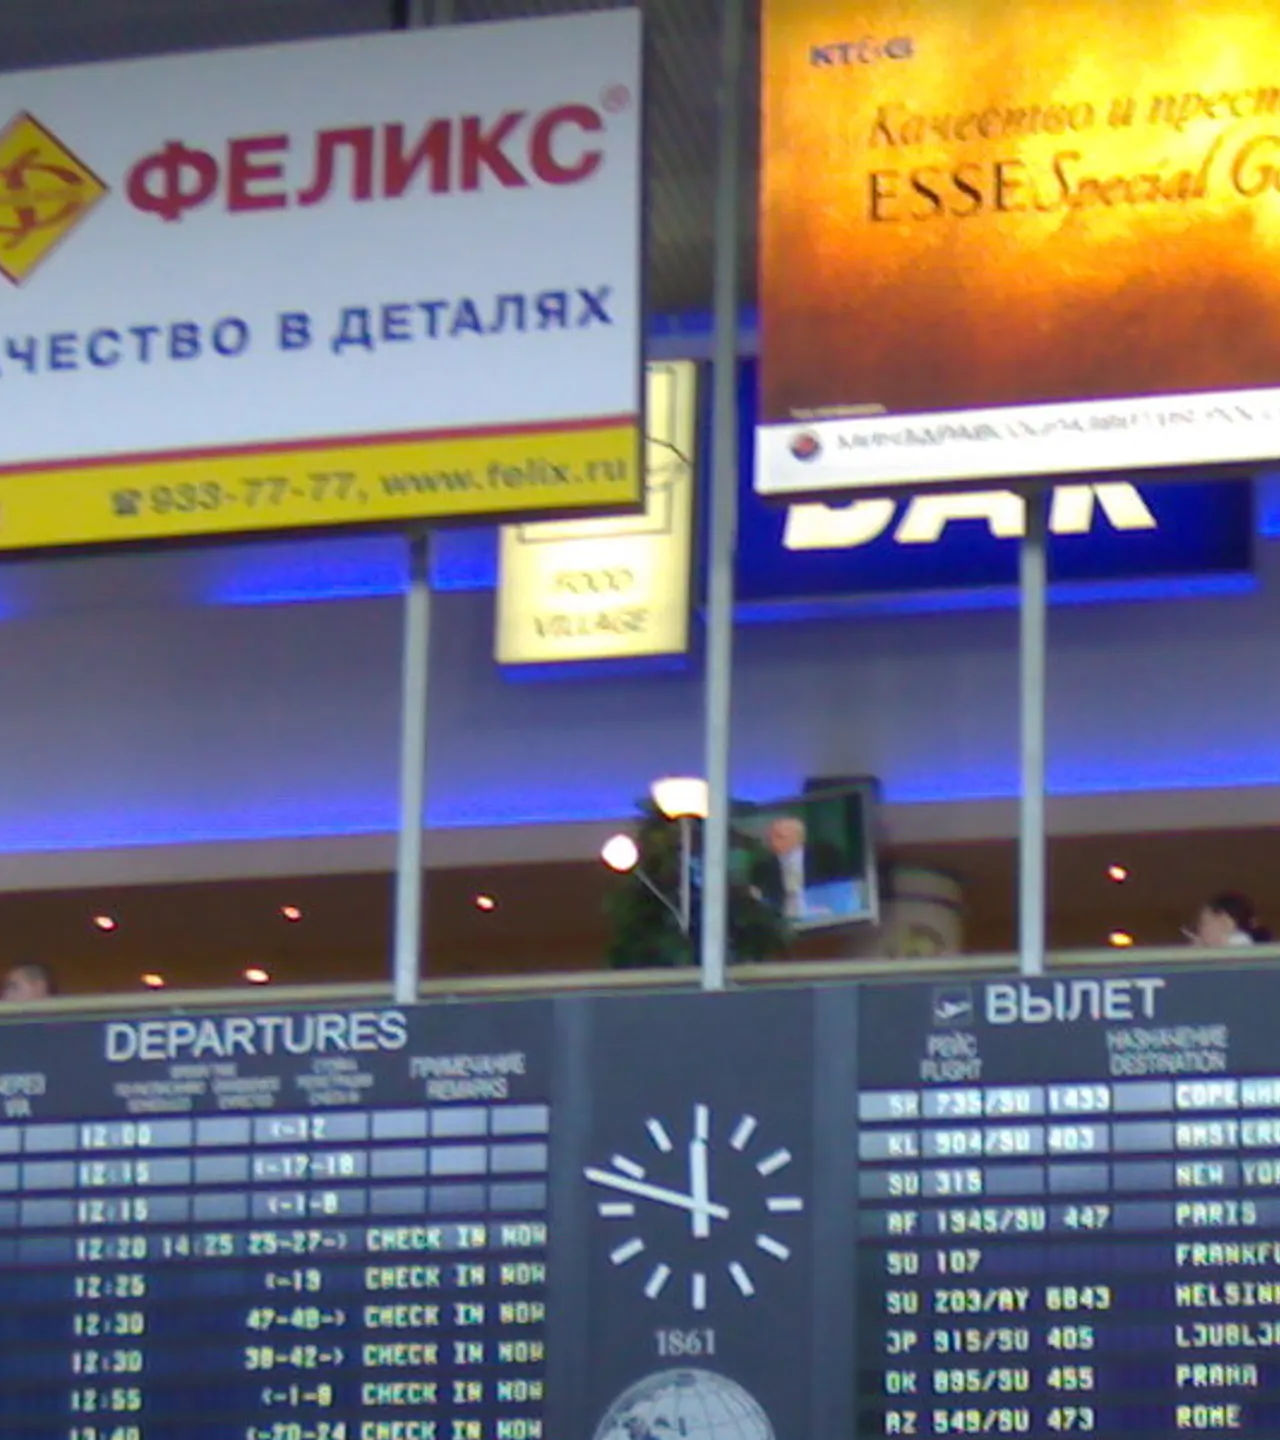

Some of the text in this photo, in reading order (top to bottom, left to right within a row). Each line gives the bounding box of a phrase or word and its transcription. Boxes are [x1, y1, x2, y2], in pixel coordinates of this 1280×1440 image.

[125, 103, 604, 222] ФЕЛИКС
[866, 160, 1023, 224] ESSE
[276, 310, 312, 350] В
[331, 286, 614, 356] ДЕТАЛЯХ
[985, 977, 1166, 1023] ВЫЛЕТ
[105, 1011, 408, 1061] DEPARTURES
[1176, 1164, 1223, 1189] NEW
[1176, 1202, 1257, 1227] PARIS
[366, 1228, 442, 1252] CHECK
[886, 1251, 918, 1275] SU
[937, 1249, 982, 1274] 107
[365, 1266, 440, 1290] CHECK
[363, 1305, 439, 1329] CHECK
[654, 1329, 716, 1356] 1861
[1047, 1325, 1095, 1350] 405
[362, 1343, 438, 1367] CHECK
[1047, 1365, 1095, 1391] 455
[1176, 1363, 1258, 1388] PRAHA
[362, 1382, 437, 1406] CHECK
[1047, 1406, 1095, 1431] 473
[1176, 1404, 1242, 1429] ROME
